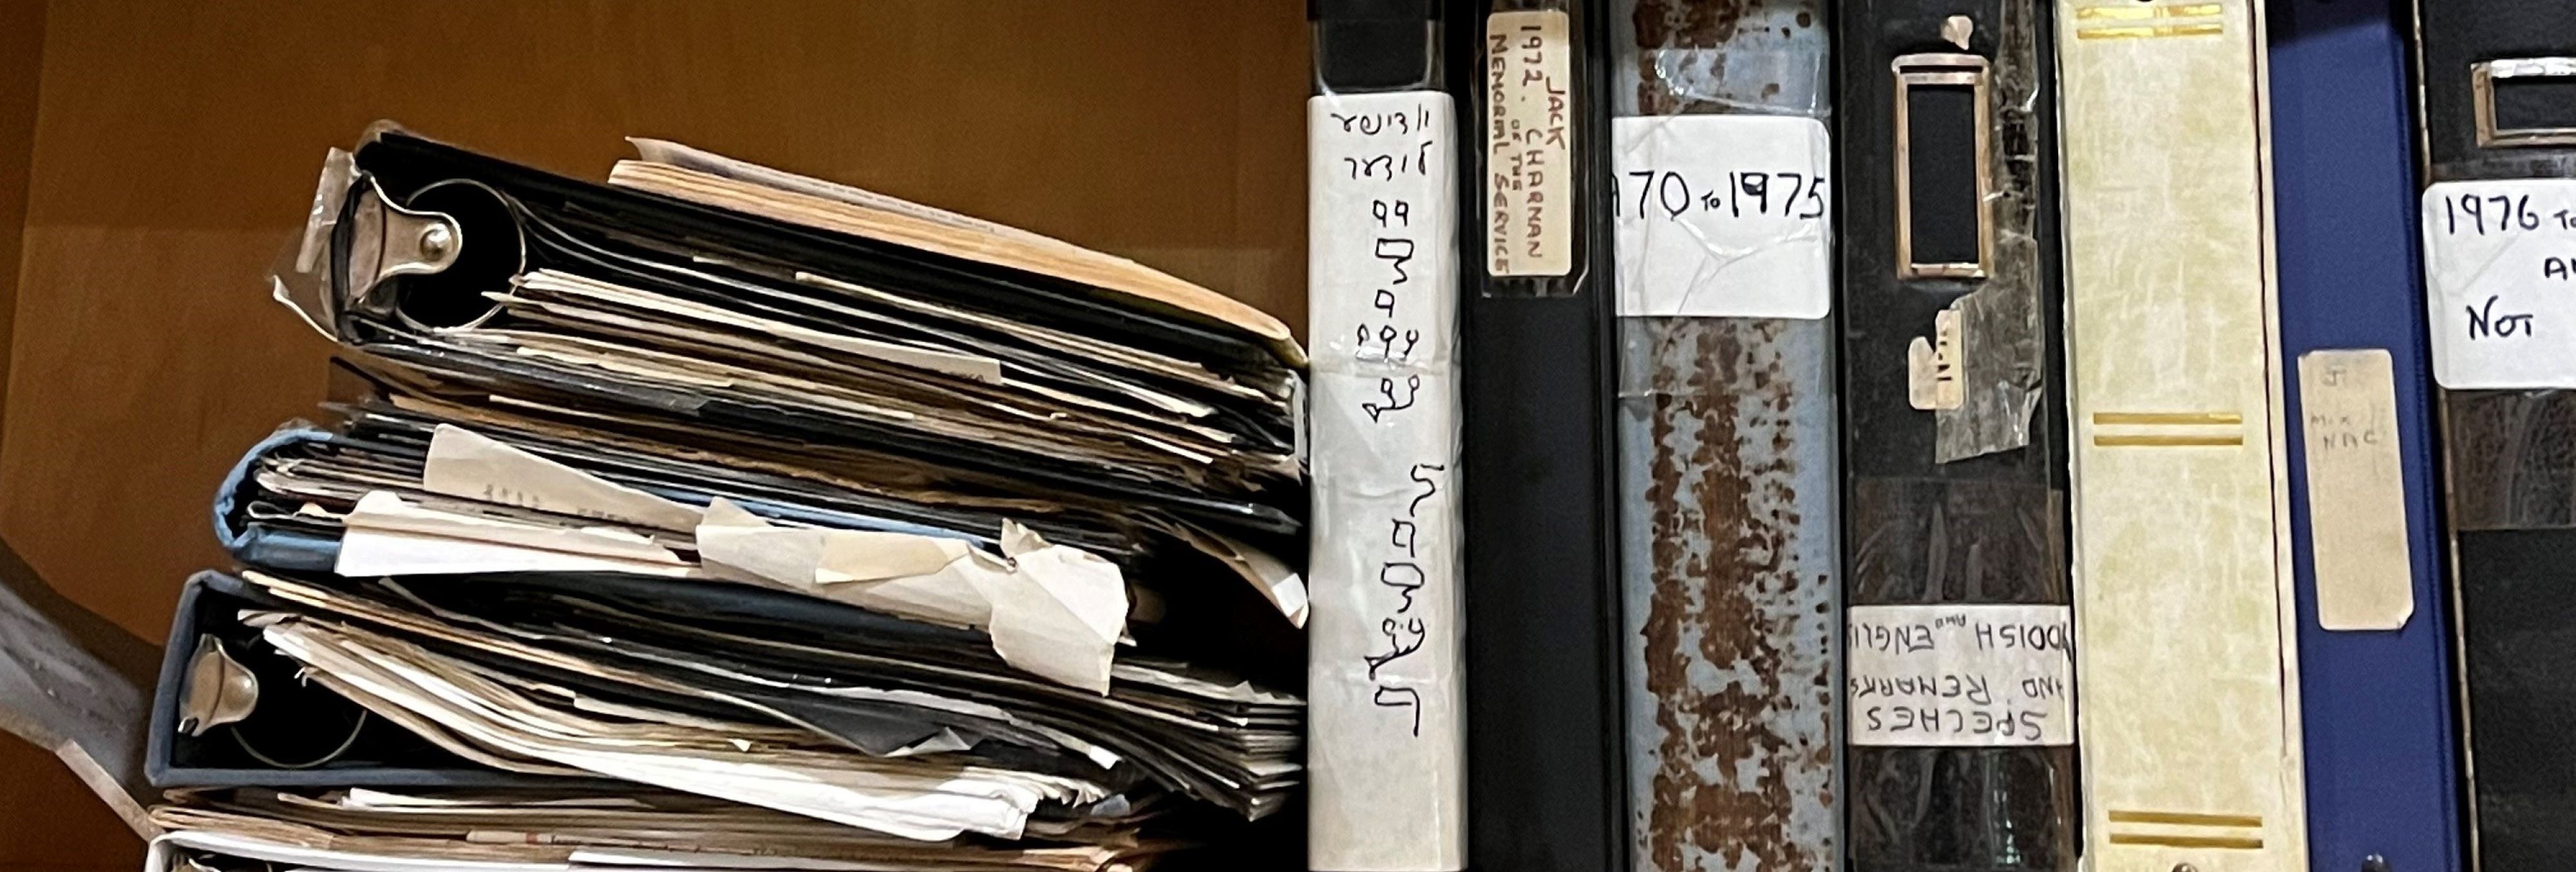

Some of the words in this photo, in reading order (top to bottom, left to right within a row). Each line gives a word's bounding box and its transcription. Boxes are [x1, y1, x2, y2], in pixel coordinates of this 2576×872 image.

[1546, 75, 1566, 150] JACK
[1730, 170, 1826, 220] 1975
[2445, 193, 2539, 235] 1976
[1493, 173, 1510, 274] SERVICE
[1850, 674, 1991, 706] REMARKS
[1867, 705, 2048, 741] SPECHES
